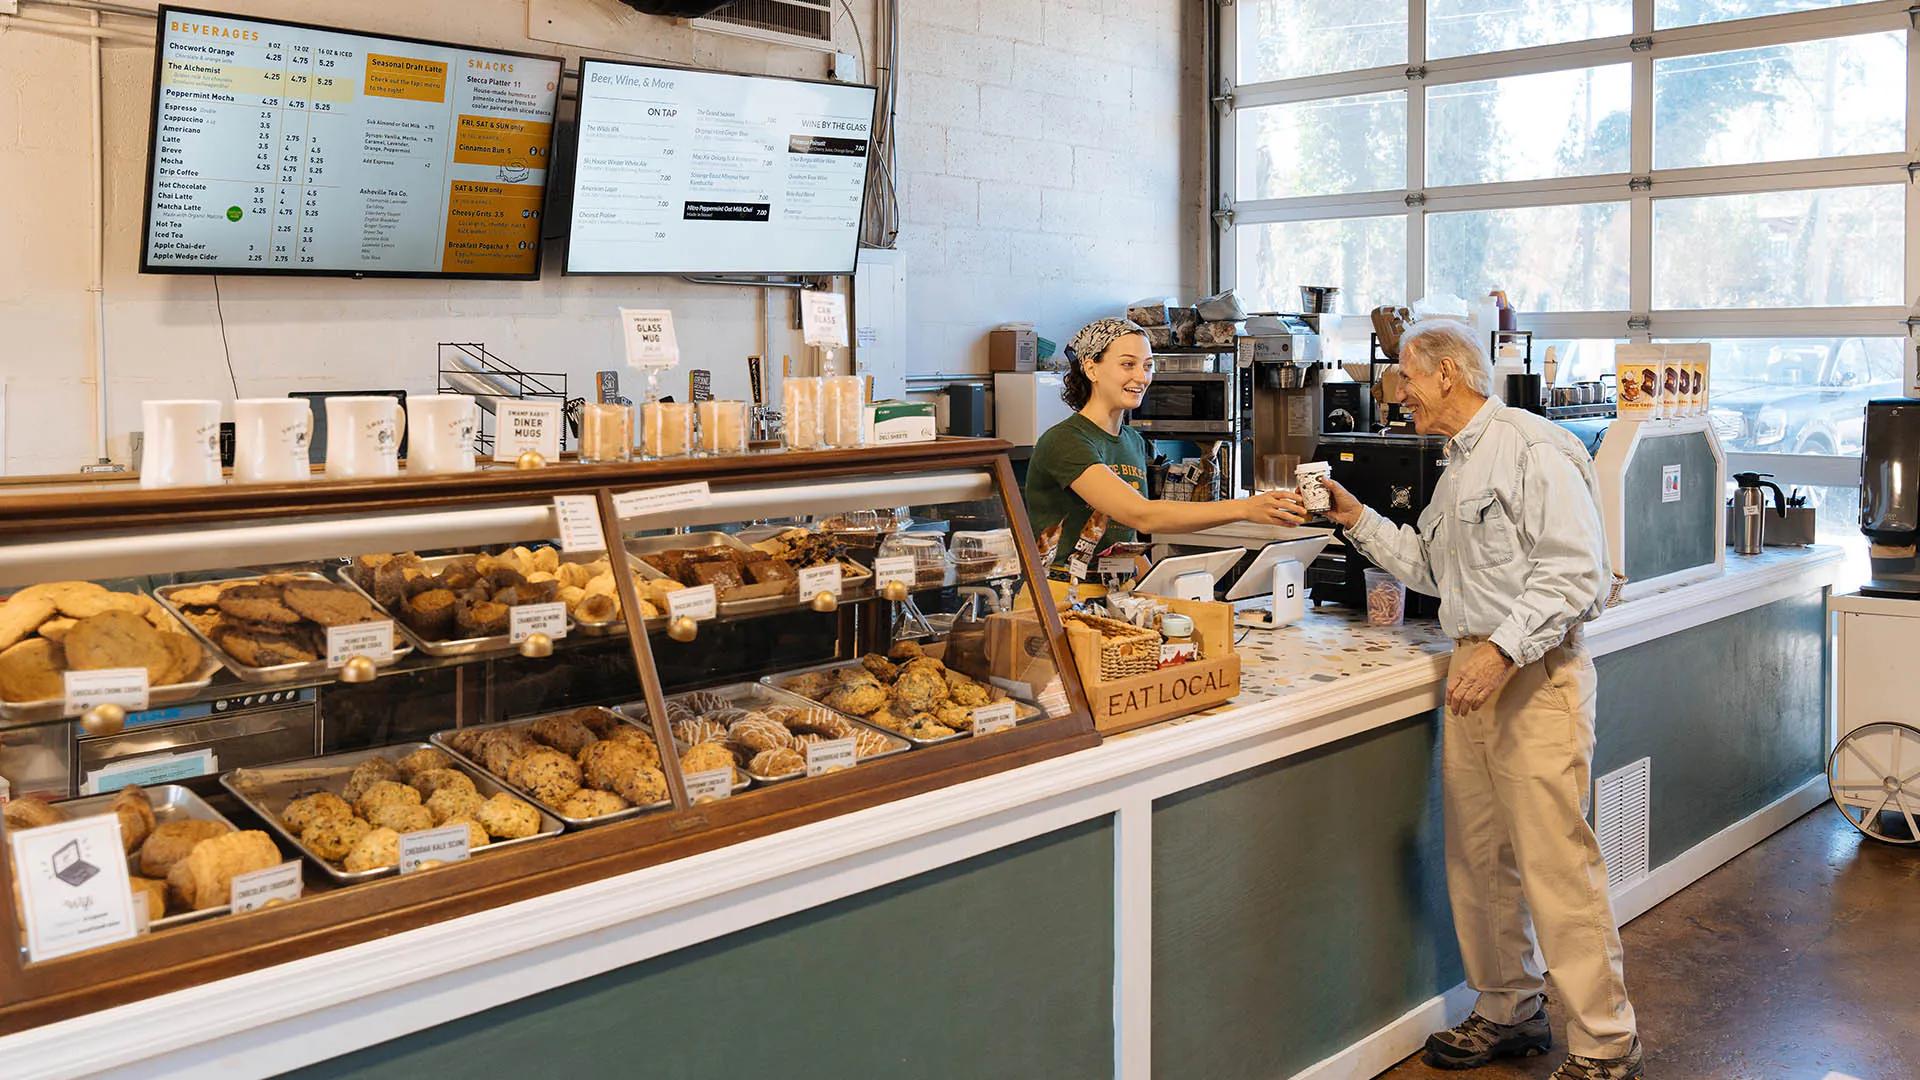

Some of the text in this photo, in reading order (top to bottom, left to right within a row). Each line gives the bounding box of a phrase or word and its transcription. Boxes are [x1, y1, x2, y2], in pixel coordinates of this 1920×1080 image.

[171, 21, 259, 41] BEVERAGES
[169, 42, 235, 57] Chocwork Orange
[266, 53, 282, 62] 4.25
[292, 56, 308, 65] 4.75
[168, 62, 221, 74] The Alchemist
[319, 59, 335, 68] 5.25
[372, 58, 443, 73] Seasonal Draft Latte
[468, 59, 514, 73] SNACKS
[264, 72, 280, 81] 4.25
[290, 75, 307, 84] 4.75
[370, 75, 388, 83] Check
[467, 75, 487, 85] Stecca
[489, 77, 511, 87] Platter
[591, 72, 674, 90] Beer, Wine, & More
[317, 78, 333, 86] 5.25
[166, 89, 235, 102] Peppermint Mocha
[387, 87, 404, 95] right!
[262, 97, 278, 106] 4.25
[289, 100, 305, 109] 4.75
[165, 103, 197, 113] Espresso
[315, 103, 331, 111] 5.25
[261, 111, 271, 119] 2.5
[647, 107, 678, 118] ON TAP
[164, 114, 204, 124] Cappuccino
[163, 125, 201, 134] Americano
[461, 119, 475, 127] FRI,
[510, 124, 525, 132] only
[801, 119, 867, 132] WINE BY THE GLASS
[162, 135, 181, 144] Latte
[161, 146, 182, 154] Breve
[459, 143, 492, 153] Cinnamon
[160, 157, 183, 165] Mocha
[159, 168, 199, 177] Drip Coffee
[283, 165, 297, 173] 4.75
[158, 181, 207, 191] Hot Chocolate
[158, 192, 193, 201] Chai Latte
[360, 188, 387, 197] Asheville
[388, 189, 398, 197] Tea
[157, 203, 201, 212] Matcha Latte
[252, 207, 266, 215] 4.25
[452, 209, 475, 217] Cheesy
[278, 225, 292, 233] 2.25
[155, 231, 170, 239] Iced
[154, 242, 206, 250] Apple Chai-der
[449, 241, 477, 249] Breakfast
[153, 252, 218, 261] Apple Wedge Cider
[817, 306, 832, 314] CAN
[814, 315, 836, 325] GLASS
[637, 324, 662, 333] GLASS
[642, 334, 660, 342] MUG
[514, 418, 543, 427] DINER
[514, 429, 542, 438] MUGS
[1108, 668, 1230, 717] EAT LOCAL
